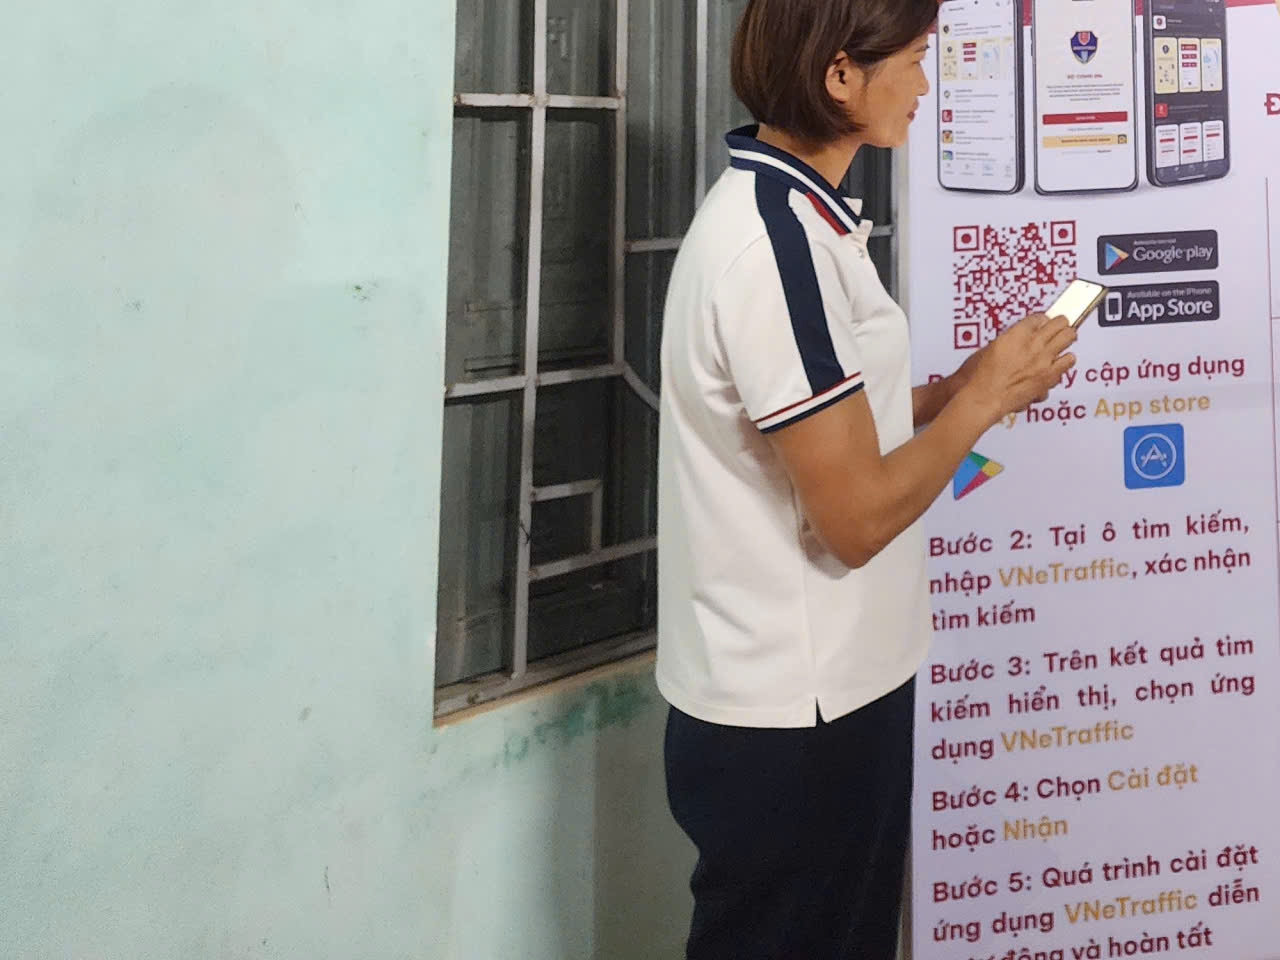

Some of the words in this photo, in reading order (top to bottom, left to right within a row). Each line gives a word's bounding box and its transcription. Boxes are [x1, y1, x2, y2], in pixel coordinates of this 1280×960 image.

[1133, 246, 1183, 264] Google
[1186, 246, 1213, 261] play
[1128, 302, 1164, 321] App
[1168, 299, 1213, 315] Store
[1086, 363, 1129, 388] cập
[1138, 358, 1181, 382] ứng
[1188, 356, 1245, 380] dụng
[1027, 400, 1086, 426] hoặc
[1094, 398, 1142, 420] App
[1150, 394, 1210, 415] store
[929, 533, 993, 557] Bước
[1010, 531, 1032, 551] 2:
[1049, 524, 1086, 551] Tại
[1102, 522, 1116, 542] ô
[1132, 518, 1170, 540] tìm
[1186, 510, 1249, 535] kiếm,
[929, 572, 991, 596] nhập
[999, 559, 1138, 587] VNeTraffic,
[1145, 556, 1187, 575] xác
[1194, 549, 1251, 576] nhận
[932, 608, 969, 631] tìm
[978, 601, 1035, 627] kiếm
[931, 660, 994, 684] Bước
[1008, 657, 1031, 677] 3:
[1044, 651, 1097, 673] Trên
[1111, 641, 1147, 667] kết
[1160, 637, 1204, 663] quả
[1216, 635, 1253, 656] tìm
[931, 695, 990, 722] kiếm
[1008, 685, 1059, 714] hiển
[1078, 684, 1117, 710] thị,
[1135, 679, 1194, 704] chọn
[1211, 673, 1255, 696] ứng
[931, 739, 994, 764] dụng
[1001, 721, 1135, 753] VNeTraffic
[932, 786, 996, 812] Bước
[1005, 783, 1029, 802] 4:
[1037, 777, 1100, 802] Chọn
[1107, 767, 1149, 791] Cài
[1156, 762, 1198, 790] đặt
[931, 825, 995, 853] hoặc
[1003, 816, 1068, 843] Nhận
[933, 877, 997, 903] Bước
[1008, 872, 1032, 892] 5:
[1043, 862, 1093, 889] Quá
[1103, 855, 1160, 882] trình
[1170, 849, 1206, 874] cài
[1217, 845, 1258, 871] đặt
[933, 920, 981, 943] ứng
[991, 911, 1054, 938] dụng
[1065, 890, 1198, 925] VNeTraffic
[1209, 879, 1260, 908] diễn
[1072, 939, 1100, 959] và
[1109, 935, 1169, 958] hoàn
[1177, 921, 1213, 949] tất
